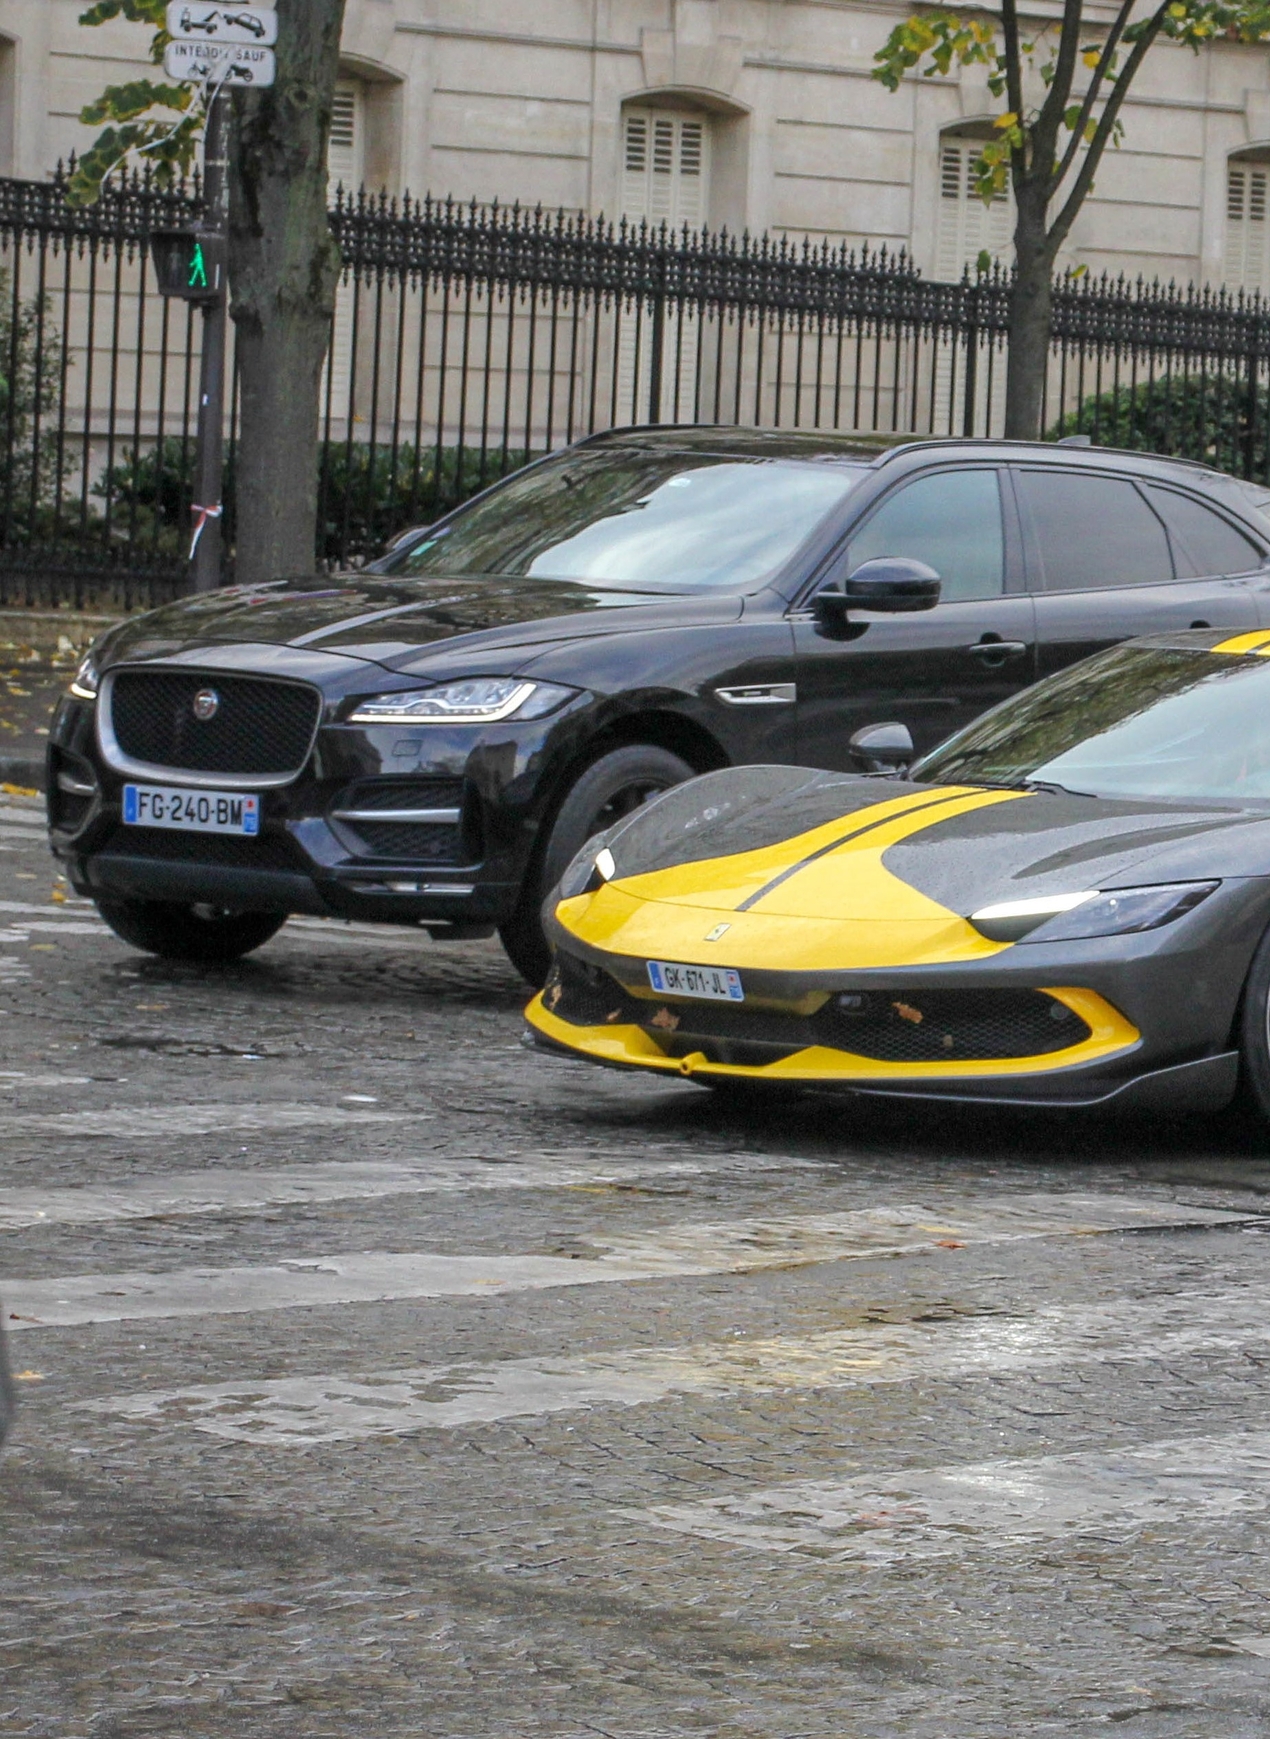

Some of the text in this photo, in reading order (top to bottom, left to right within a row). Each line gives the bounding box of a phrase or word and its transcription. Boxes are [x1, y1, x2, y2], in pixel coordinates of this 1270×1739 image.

[175, 44, 266, 62] INTED SAUF
[138, 792, 242, 826] FG-240-BM
[664, 967, 727, 995] GK-671-JL
